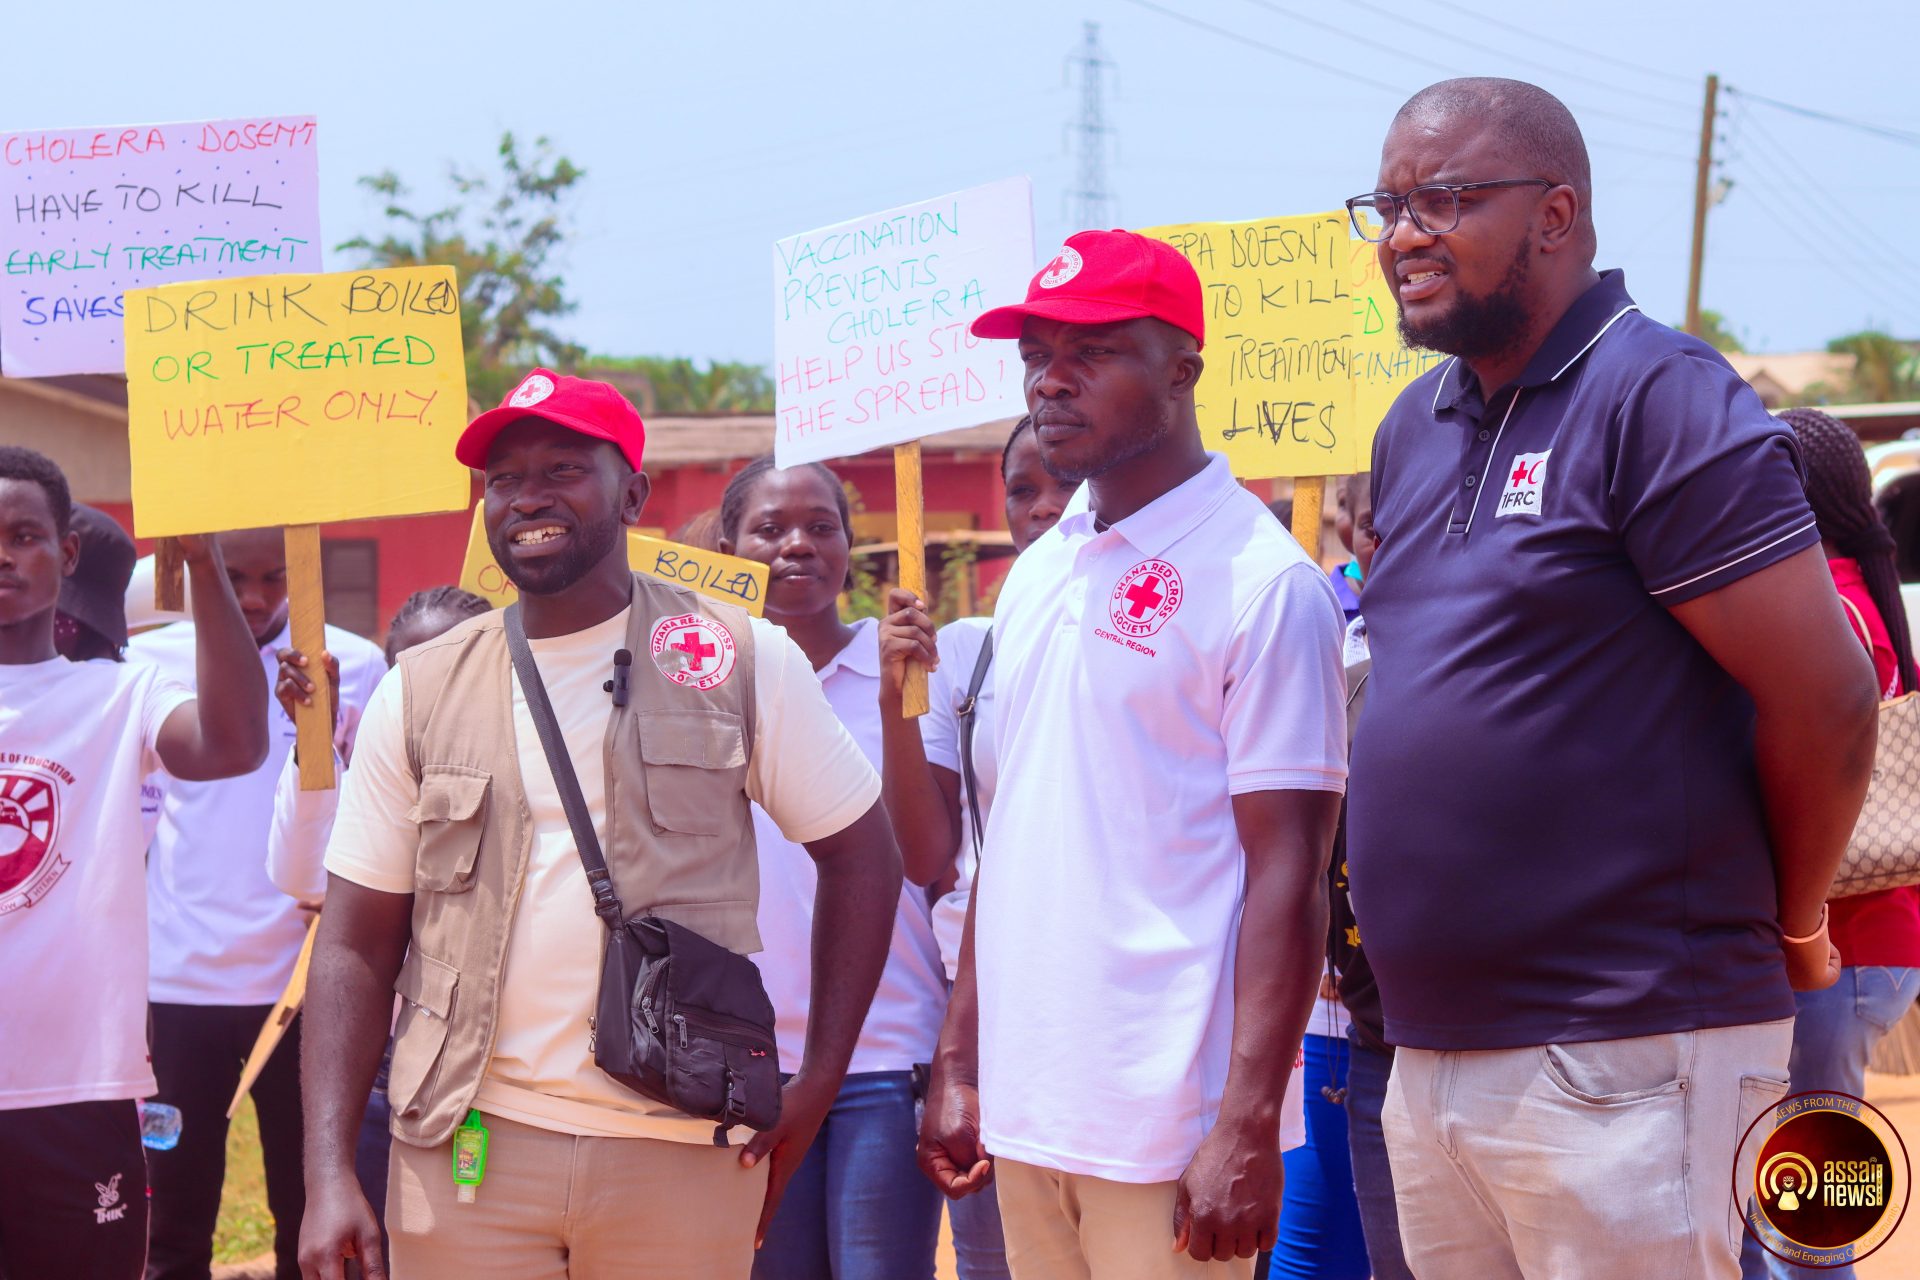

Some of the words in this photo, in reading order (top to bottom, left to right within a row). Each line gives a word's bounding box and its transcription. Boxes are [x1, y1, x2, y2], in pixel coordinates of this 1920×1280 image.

[5, 129, 165, 165] CHOLERA
[15, 189, 102, 223] HAVE
[115, 185, 161, 212] TO
[177, 183, 282, 211] KILL
[5, 243, 112, 275] EARLY
[123, 237, 308, 270] TREATMENT
[776, 200, 958, 275] VACCINATION
[1230, 218, 1341, 270] DOESN'T
[145, 283, 328, 332] DRINK
[341, 275, 457, 317] BOILED
[784, 254, 940, 321] PREVENTS
[1207, 284, 1242, 319] TO
[1258, 278, 1349, 314] KILL
[827, 278, 987, 344] CHOLERA
[153, 352, 220, 384] OR
[237, 336, 435, 375] TREATED
[781, 345, 864, 395] HELP
[877, 340, 912, 376] US
[928, 321, 993, 358] STO
[1225, 335, 1353, 387] TREATMENT
[164, 396, 309, 440] WATER
[780, 400, 836, 442] THE
[1501, 490, 1535, 509] IFRC
[653, 549, 759, 602] BOILED
[1114, 564, 1147, 600] GHANA
[1150, 562, 1173, 578] RED
[1158, 579, 1179, 619] CROSS
[654, 620, 678, 653] GHANA
[706, 622, 733, 651] CROSS
[1113, 610, 1152, 634] SOCIETY
[1094, 628, 1124, 646] CENTRAL
[1125, 639, 1157, 658] REGION
[23, 755, 76, 785] EDUCATION
